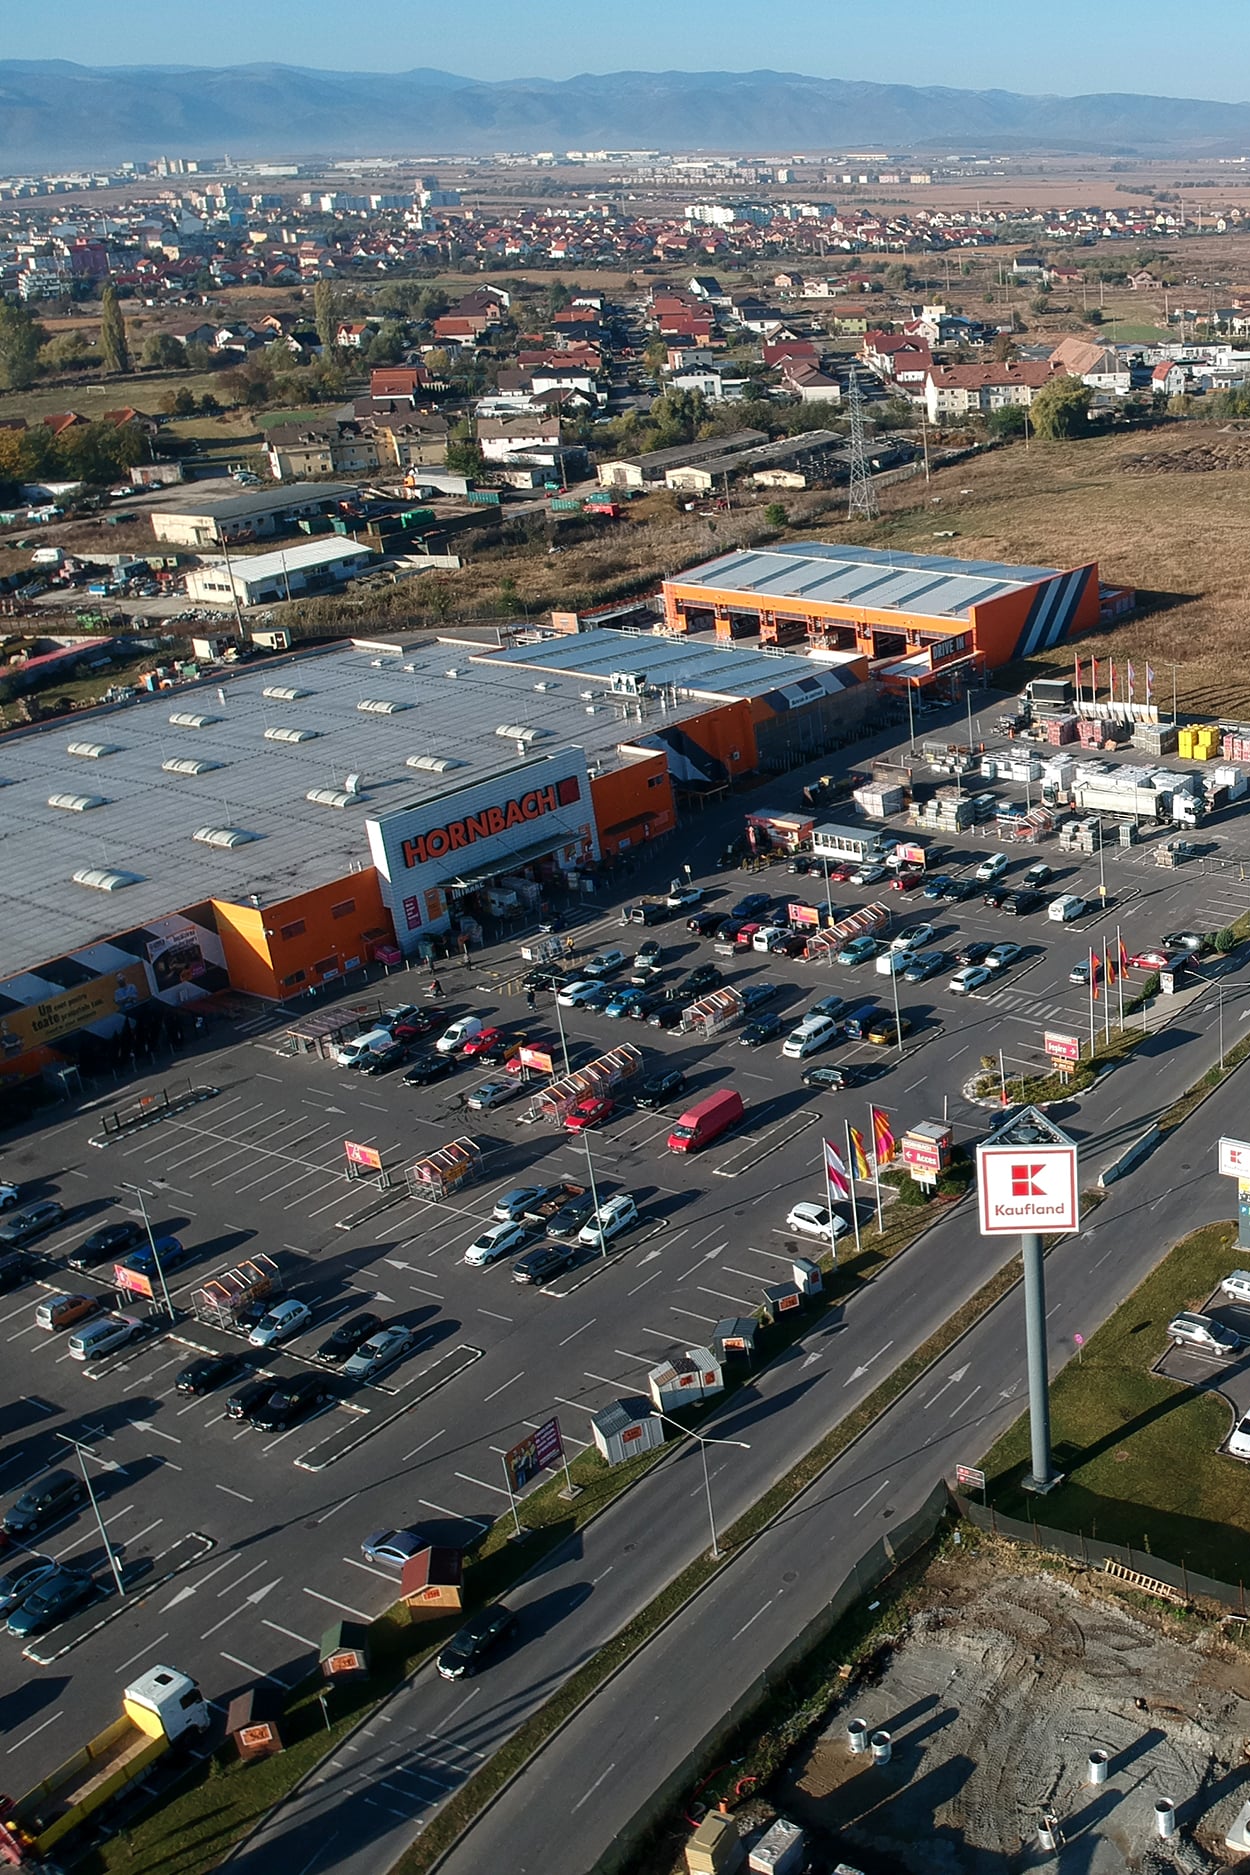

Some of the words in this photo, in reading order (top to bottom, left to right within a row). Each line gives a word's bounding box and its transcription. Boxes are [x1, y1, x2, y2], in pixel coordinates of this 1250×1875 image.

[932, 639, 954, 660] DRIVE
[956, 635, 965, 650] IN
[401, 785, 558, 869] HORNBACH
[995, 1203, 1064, 1216] Kaufland
